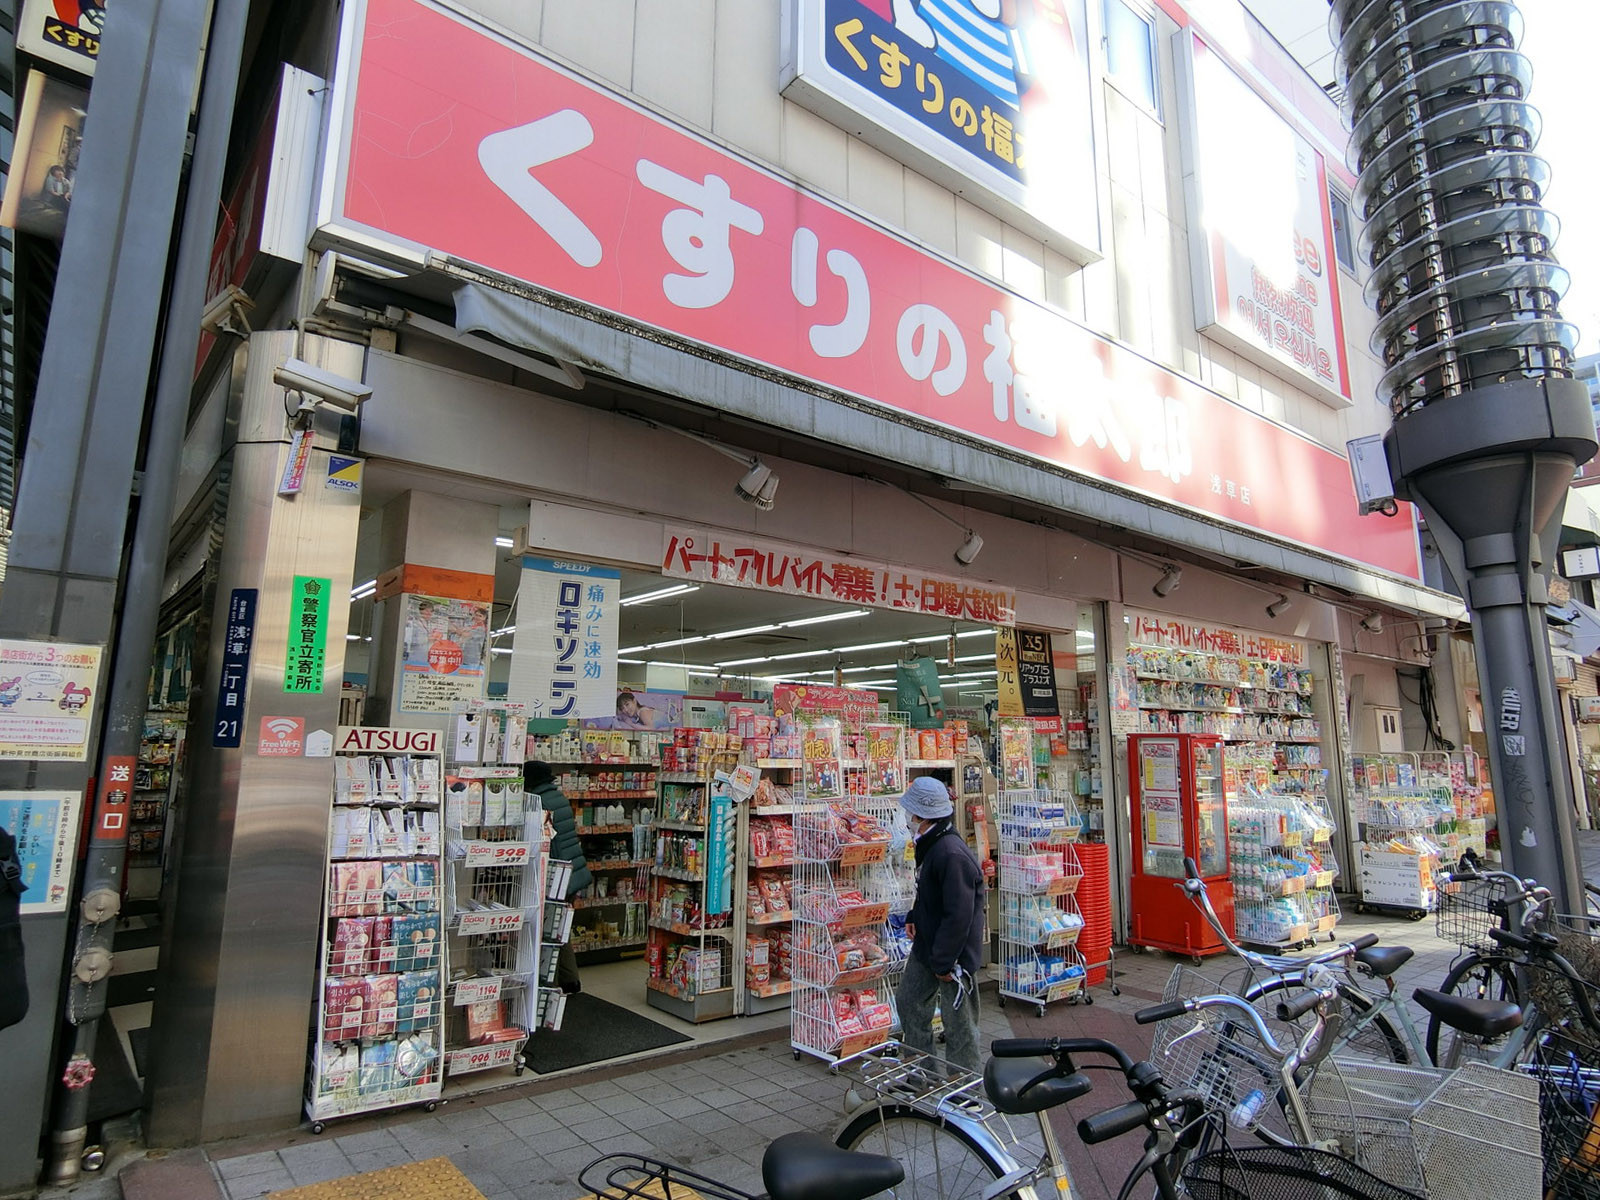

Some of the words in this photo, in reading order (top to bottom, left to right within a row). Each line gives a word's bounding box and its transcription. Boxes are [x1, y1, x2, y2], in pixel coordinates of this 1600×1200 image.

[834, 18, 1026, 171] くすりの福
[1274, 320, 1335, 382] 오십시오
[327, 478, 359, 489] ALSOK
[1209, 472, 1252, 507] 浅草店
[552, 560, 592, 573] SPEEDY
[582, 584, 606, 681] 痛みに速効
[295, 597, 320, 690] 警察官立寄所
[548, 580, 583, 718] ロキソニン
[1024, 635, 1043, 650] X5
[225, 625, 247, 706] 浅草一丁目
[217, 719, 238, 738] 21
[260, 740, 279, 748] Free
[342, 729, 437, 752] ATSUGI
[495, 848, 526, 857] 398
[864, 848, 883, 856] 199
[490, 914, 521, 925] 1194
[479, 985, 498, 995] 1194
